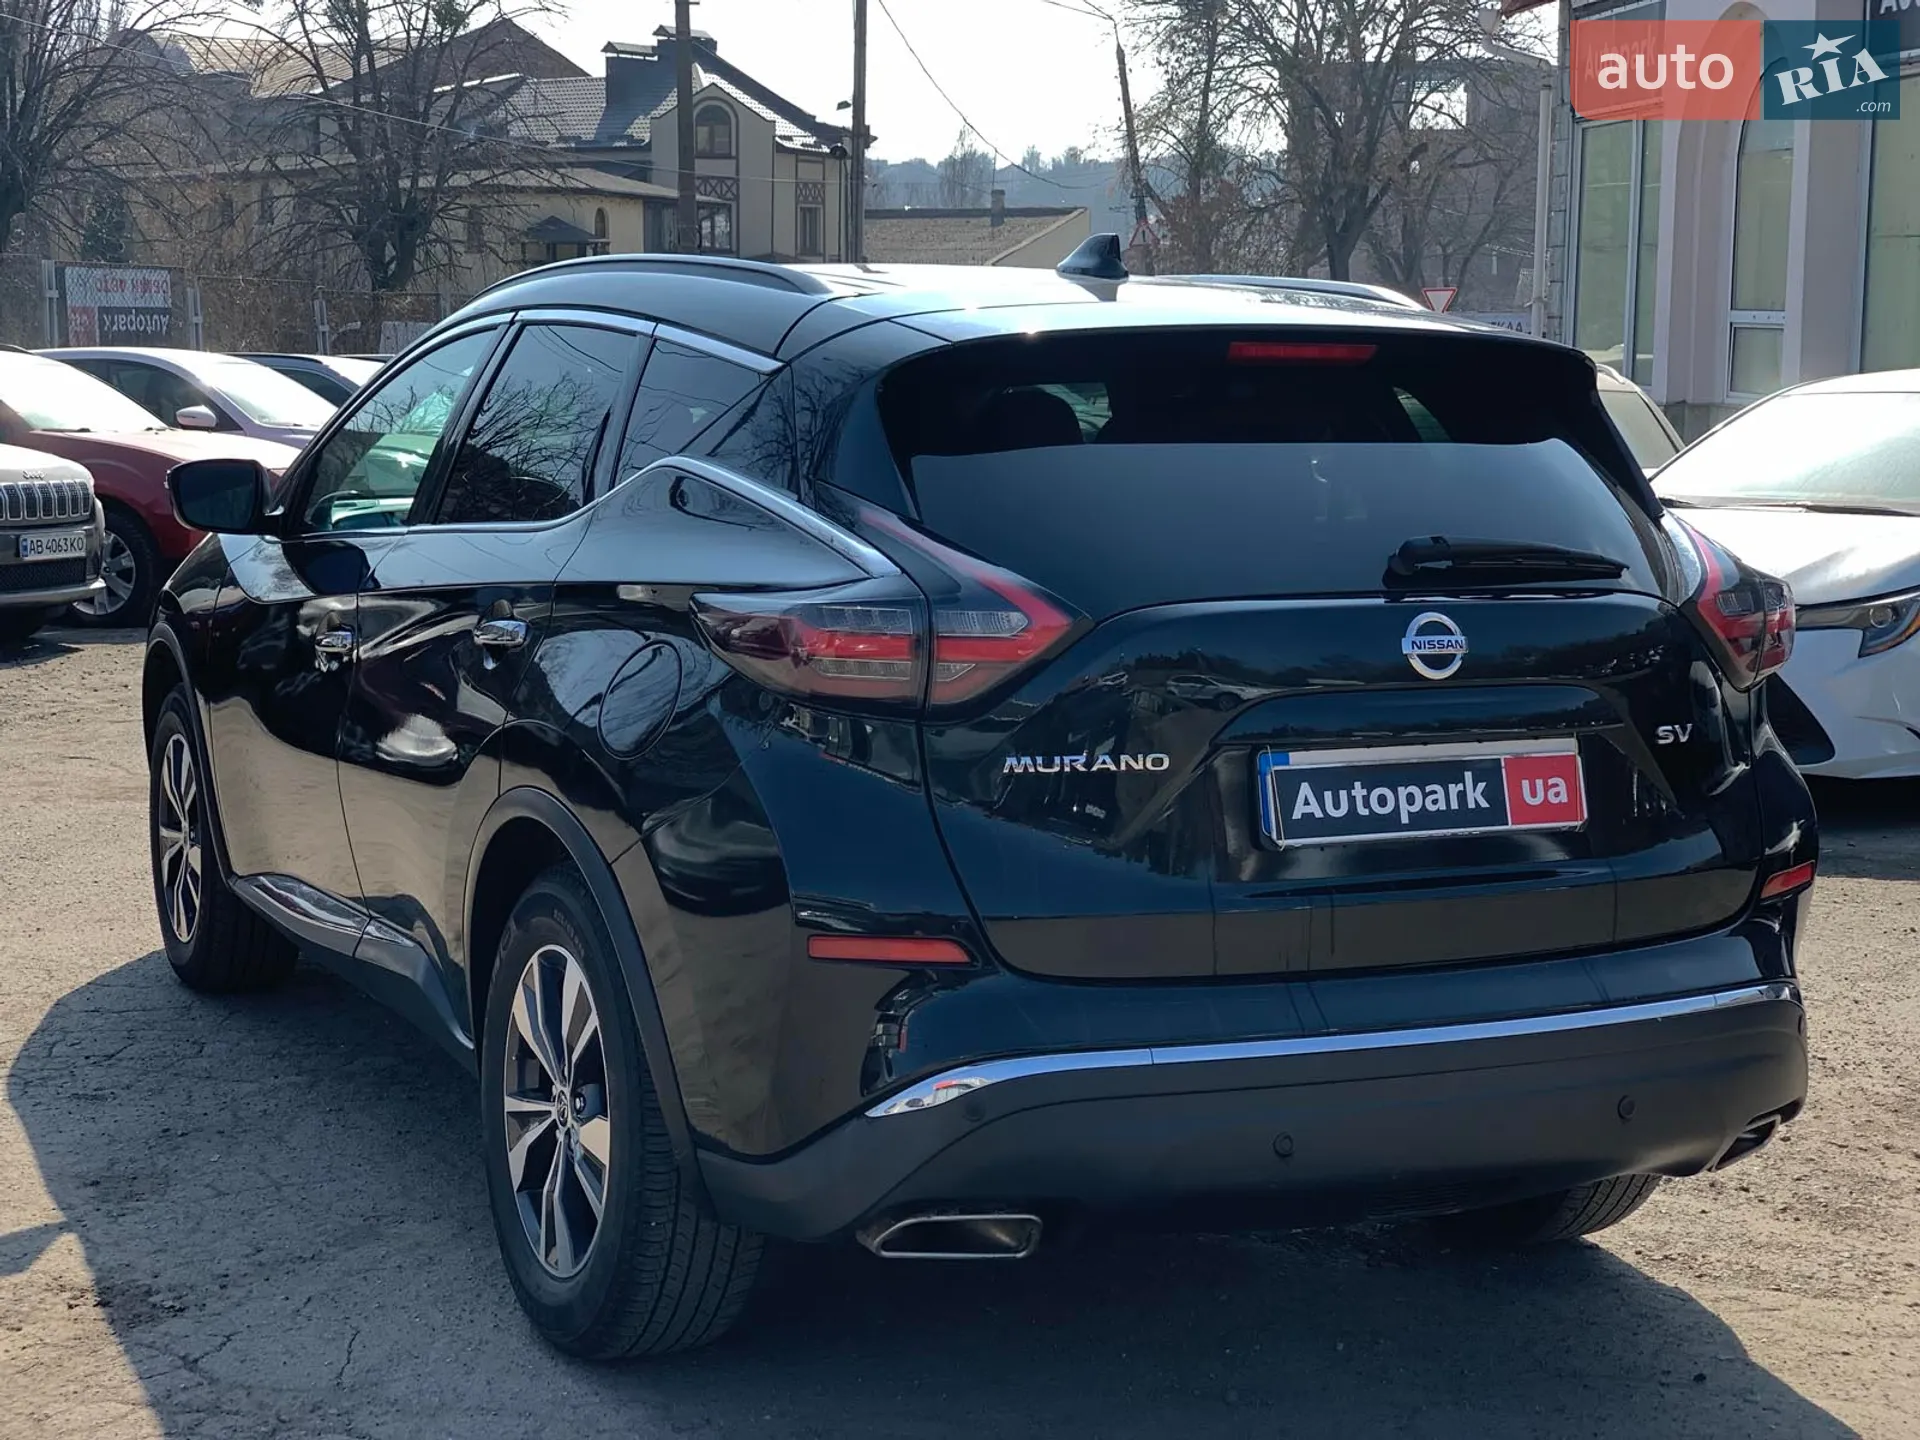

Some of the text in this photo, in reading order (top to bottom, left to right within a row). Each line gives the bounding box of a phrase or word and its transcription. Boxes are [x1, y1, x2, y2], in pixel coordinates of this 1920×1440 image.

[102, 309, 170, 337] Autopark
[1411, 639, 1464, 651] NISSAN
[1656, 723, 1693, 745] SV
[1002, 753, 1170, 773] MURANO
[1291, 771, 1569, 824] Autopark ua
